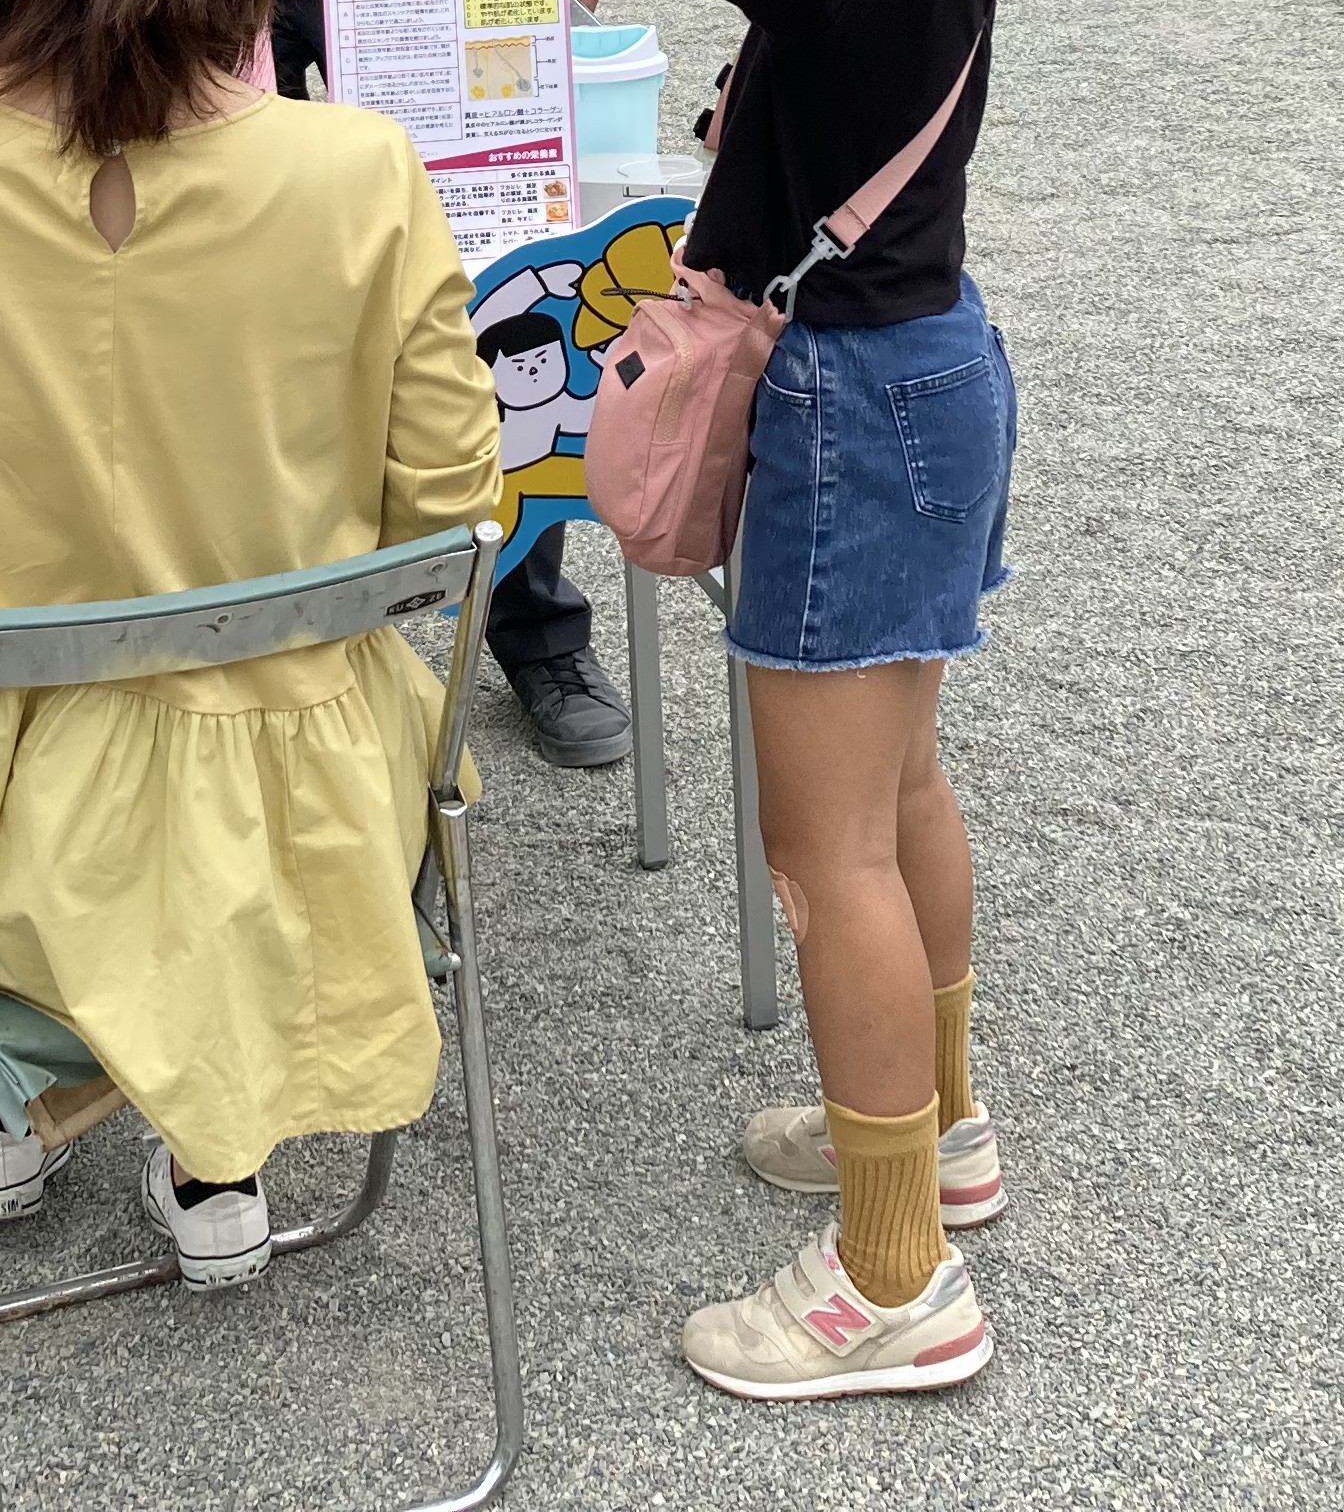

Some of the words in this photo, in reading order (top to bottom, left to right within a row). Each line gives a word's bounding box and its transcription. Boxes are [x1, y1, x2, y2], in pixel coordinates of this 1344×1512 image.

[488, 148, 558, 162] おすすめの栄養素
[803, 1293, 872, 1347] N
